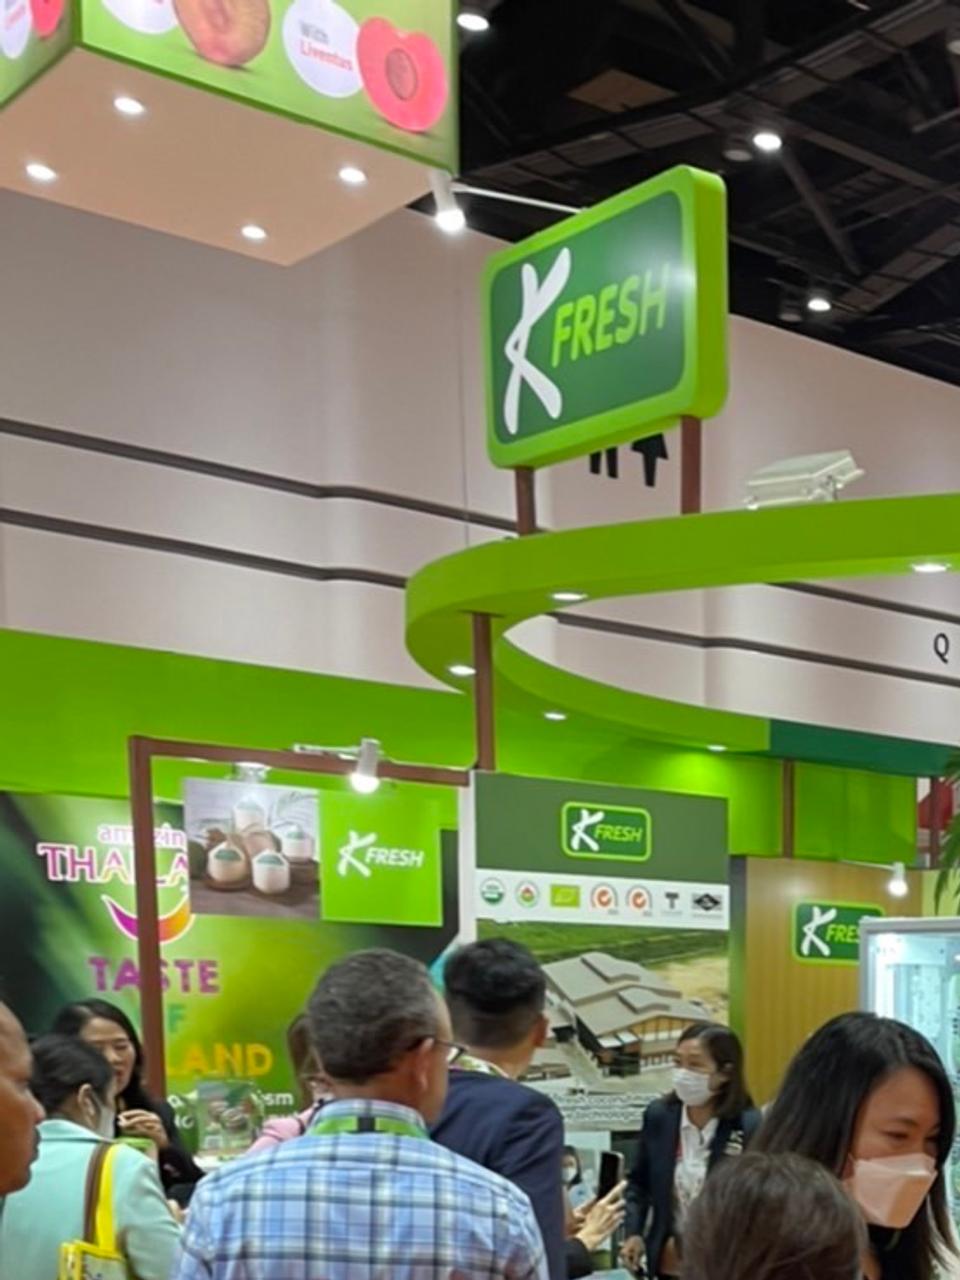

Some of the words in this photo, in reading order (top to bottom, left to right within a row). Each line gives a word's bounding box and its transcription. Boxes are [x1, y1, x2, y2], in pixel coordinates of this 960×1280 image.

[552, 263, 672, 368] FRESH
[933, 633, 950, 663] Q
[594, 824, 643, 842] FRESH
[364, 847, 425, 868] FRESH
